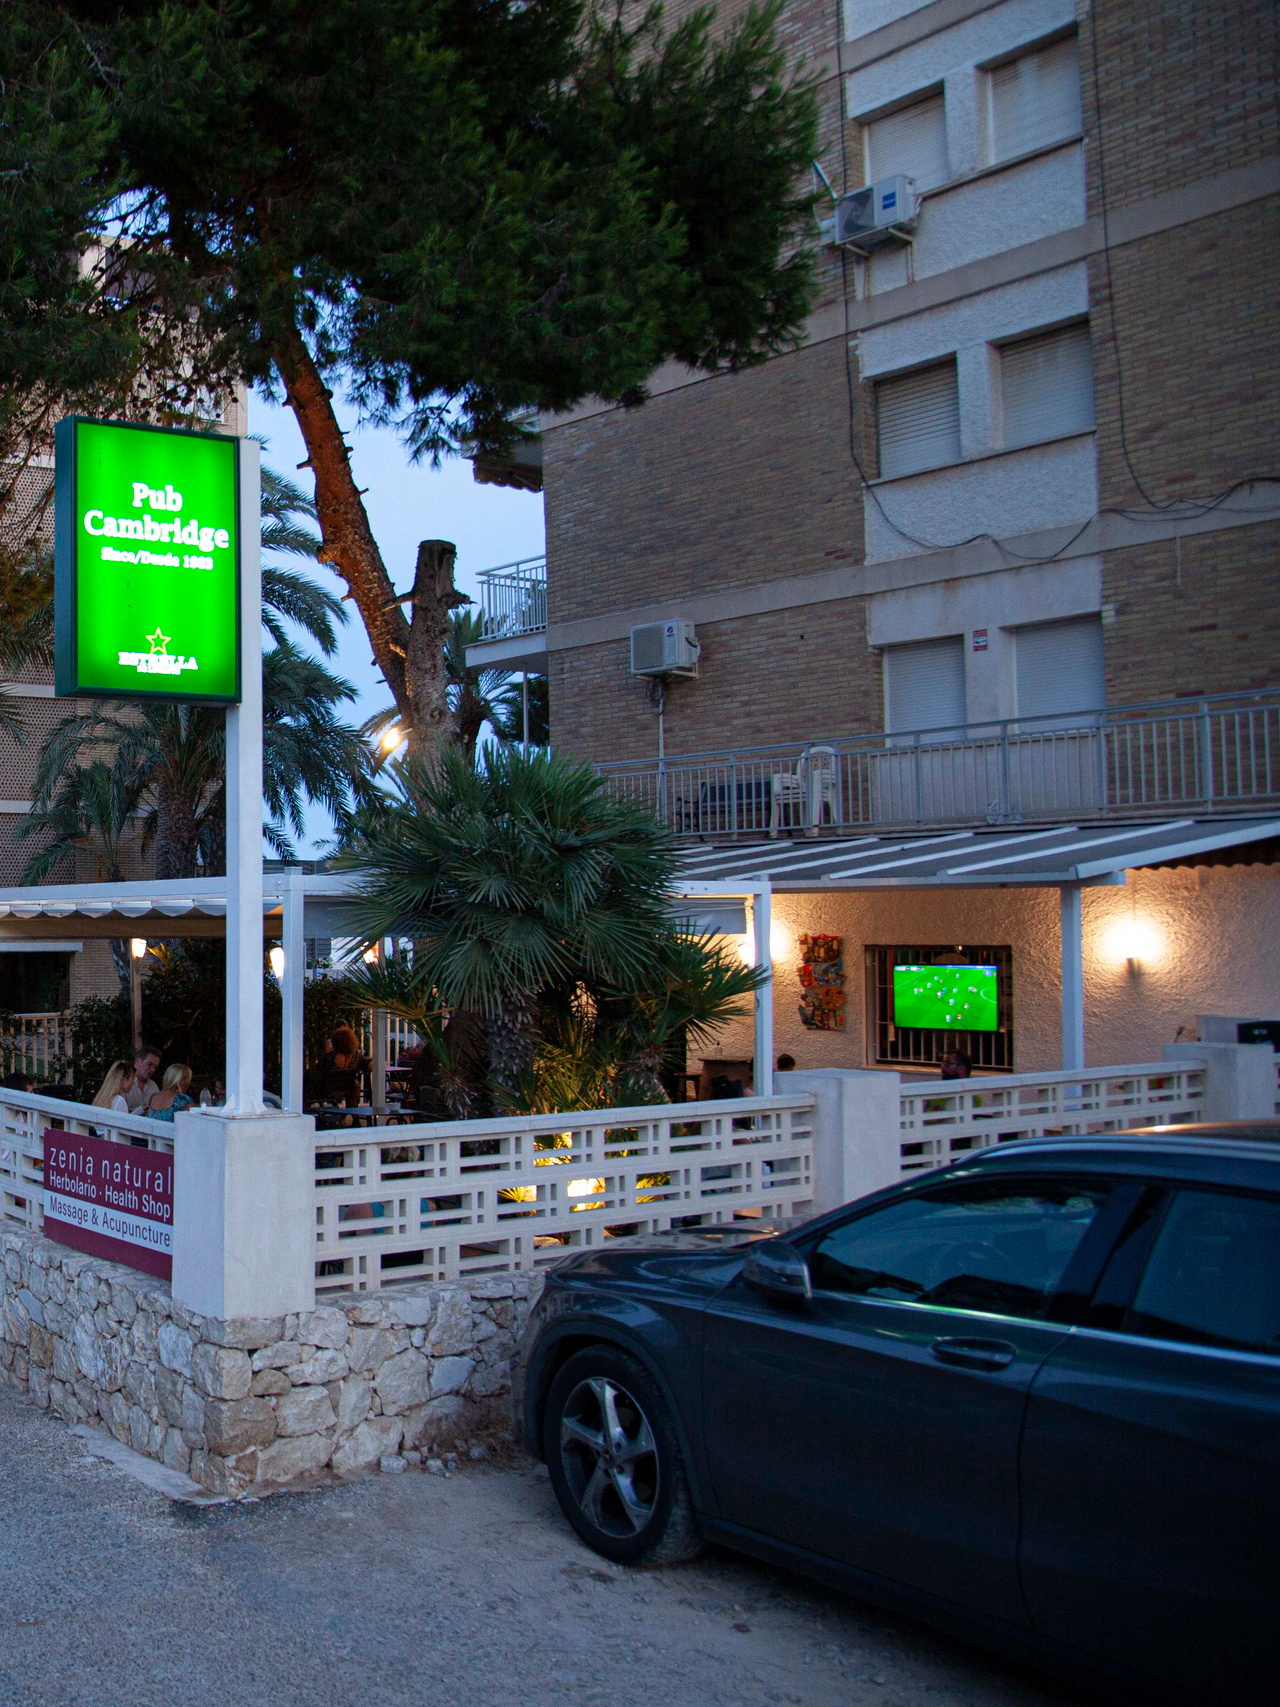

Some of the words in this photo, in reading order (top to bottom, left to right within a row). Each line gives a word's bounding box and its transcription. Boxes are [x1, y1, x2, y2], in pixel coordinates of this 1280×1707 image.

[132, 482, 183, 512] Pub
[84, 509, 229, 552] Cambridge
[50, 1147, 94, 1176] zenia
[101, 1160, 171, 1195] natural
[50, 1170, 97, 1199] Herbolario
[105, 1184, 138, 1210] Health
[142, 1194, 170, 1222] Shop
[50, 1195, 88, 1224] Massage
[91, 1208, 99, 1226] &
[102, 1211, 170, 1247] Acupuncture
